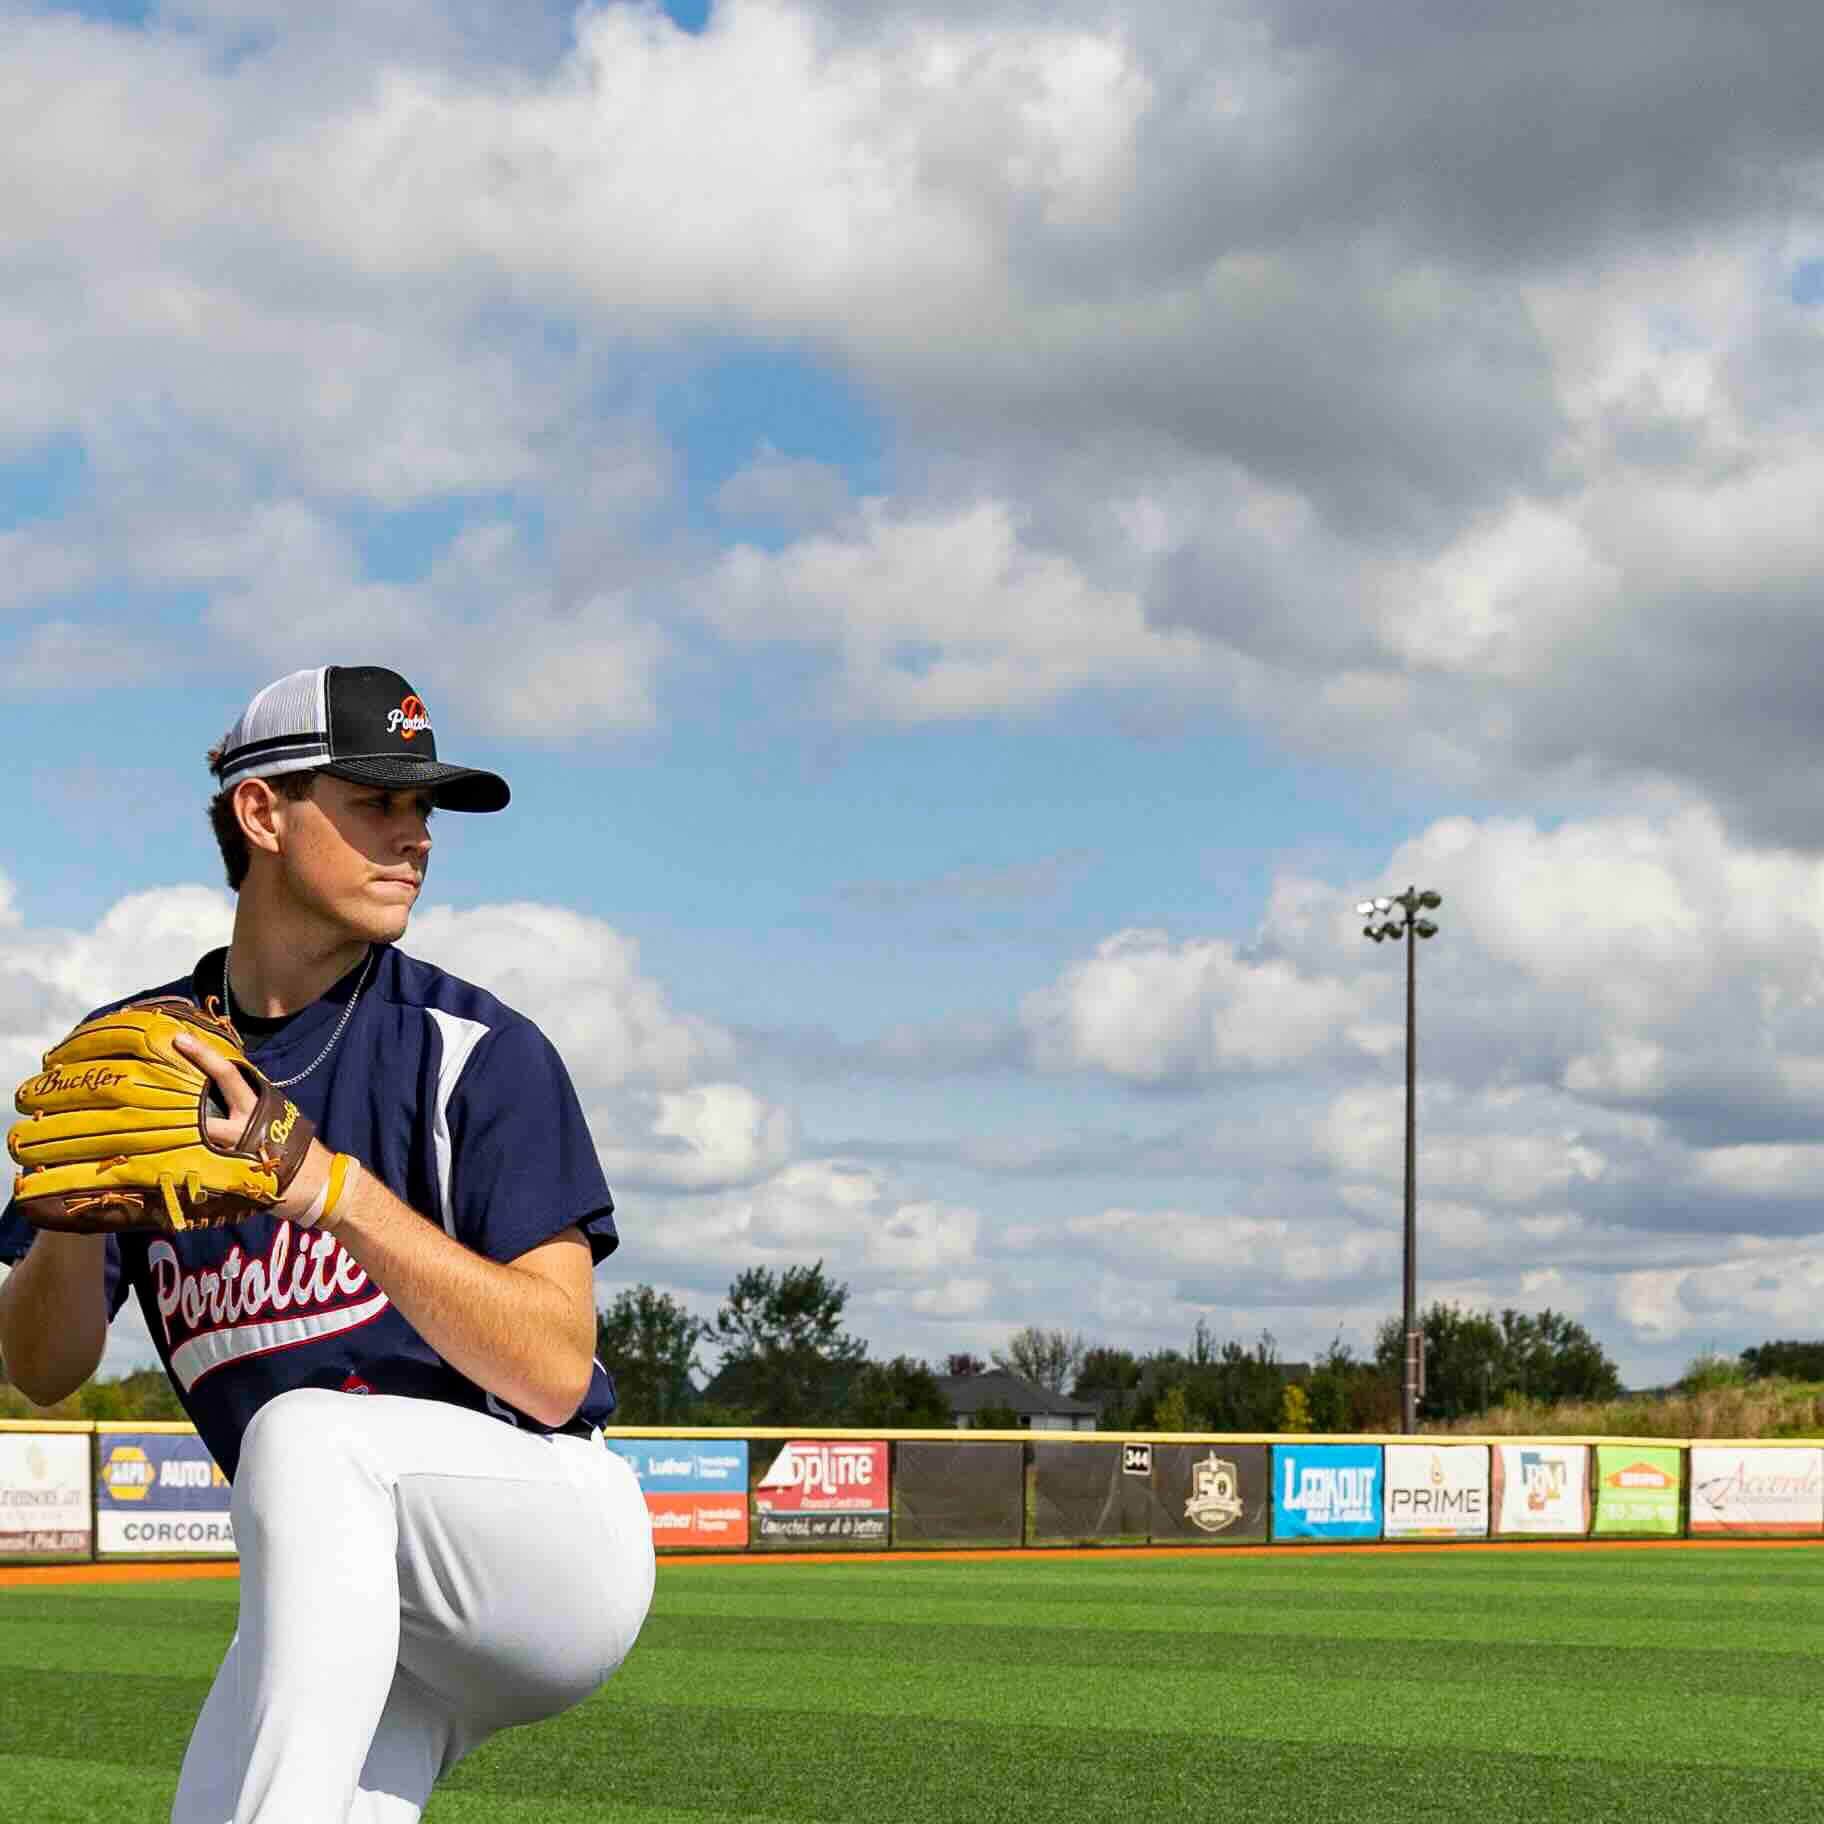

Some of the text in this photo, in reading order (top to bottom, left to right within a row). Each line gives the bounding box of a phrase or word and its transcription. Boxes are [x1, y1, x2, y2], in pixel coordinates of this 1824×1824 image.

[34, 1067, 128, 1096] Buckler
[148, 1220, 368, 1344] Portolite
[160, 1460, 211, 1487] AUTO
[1391, 1488, 1481, 1514] PRIME
